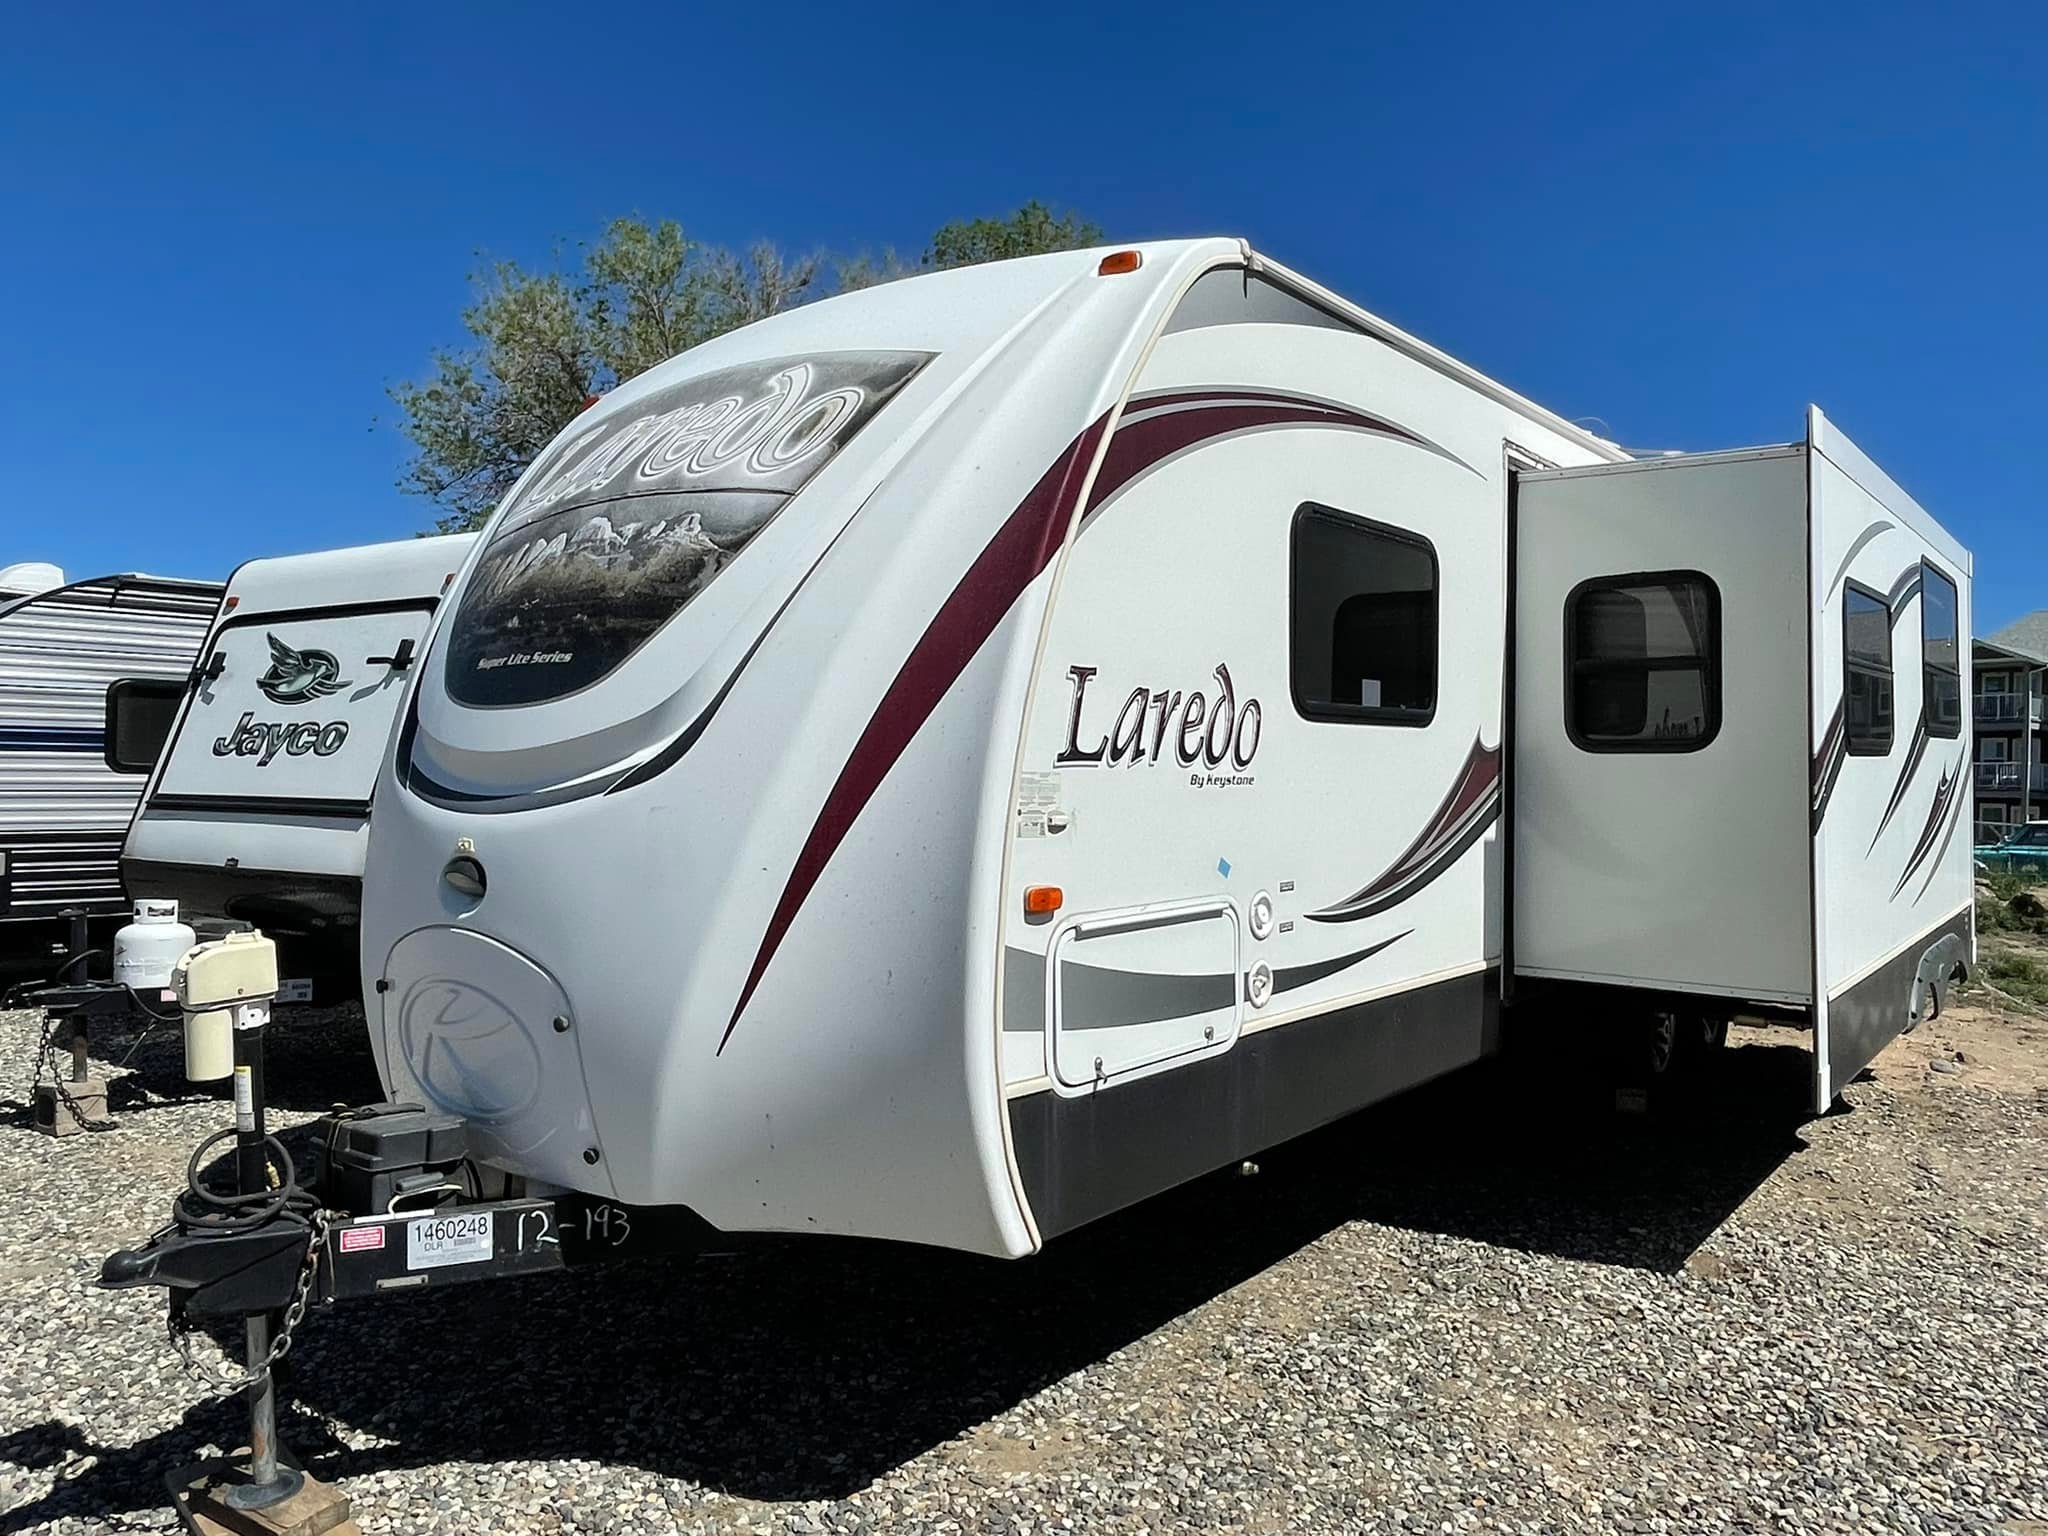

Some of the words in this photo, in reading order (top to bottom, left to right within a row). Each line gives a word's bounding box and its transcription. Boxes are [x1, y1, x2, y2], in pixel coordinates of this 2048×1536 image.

[503, 362, 866, 515] Laredo
[507, 653, 531, 666] Lite
[531, 651, 573, 664] Series
[1053, 662, 1262, 772] Laredo
[212, 711, 350, 768] Jayco
[1190, 773, 1204, 789] By
[1206, 773, 1254, 789] Keystone
[415, 1216, 488, 1242] 1460248
